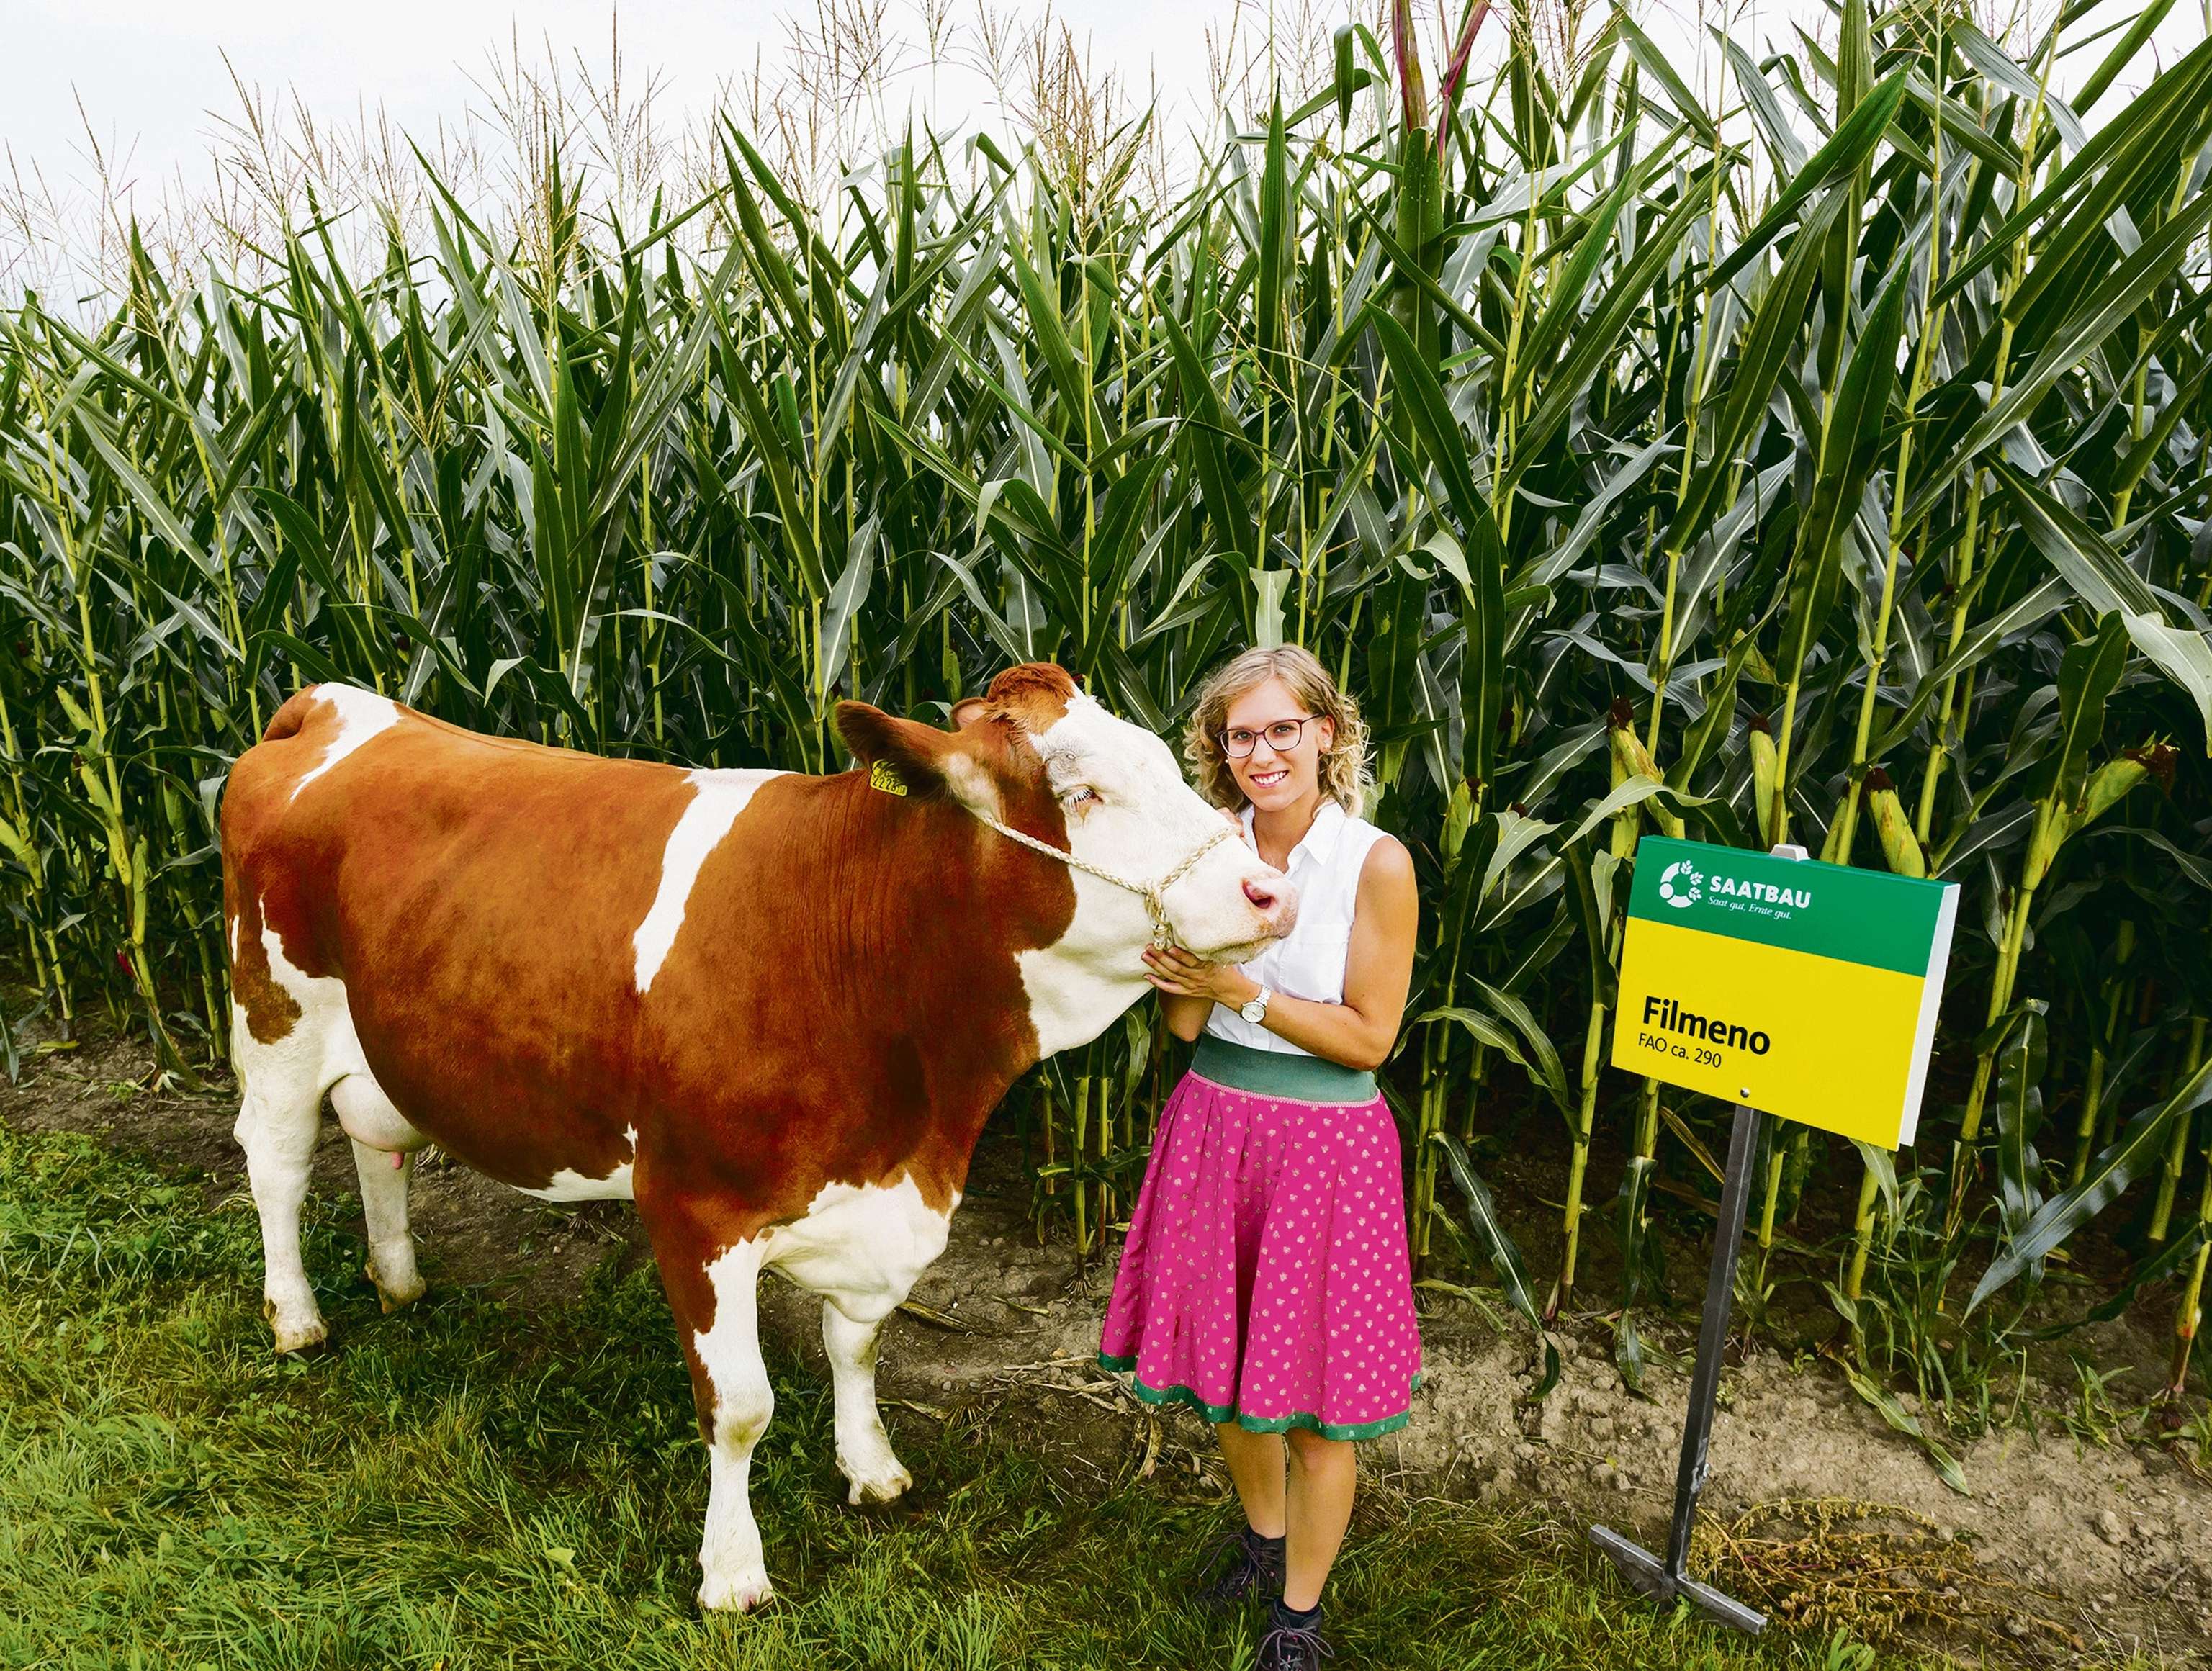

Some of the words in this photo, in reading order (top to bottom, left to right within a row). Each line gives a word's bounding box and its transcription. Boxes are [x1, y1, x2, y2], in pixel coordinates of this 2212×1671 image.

[1707, 896, 1727, 907] Saat
[1748, 903, 1773, 916] Ernte
[1773, 910, 1792, 920] gut.
[1709, 875, 1812, 909] SAATBAU
[1642, 995, 1771, 1055] Filmeno
[1638, 1032, 1668, 1053] FAO
[1671, 1045, 1689, 1060] ca.
[1694, 1048, 1722, 1068] 290
